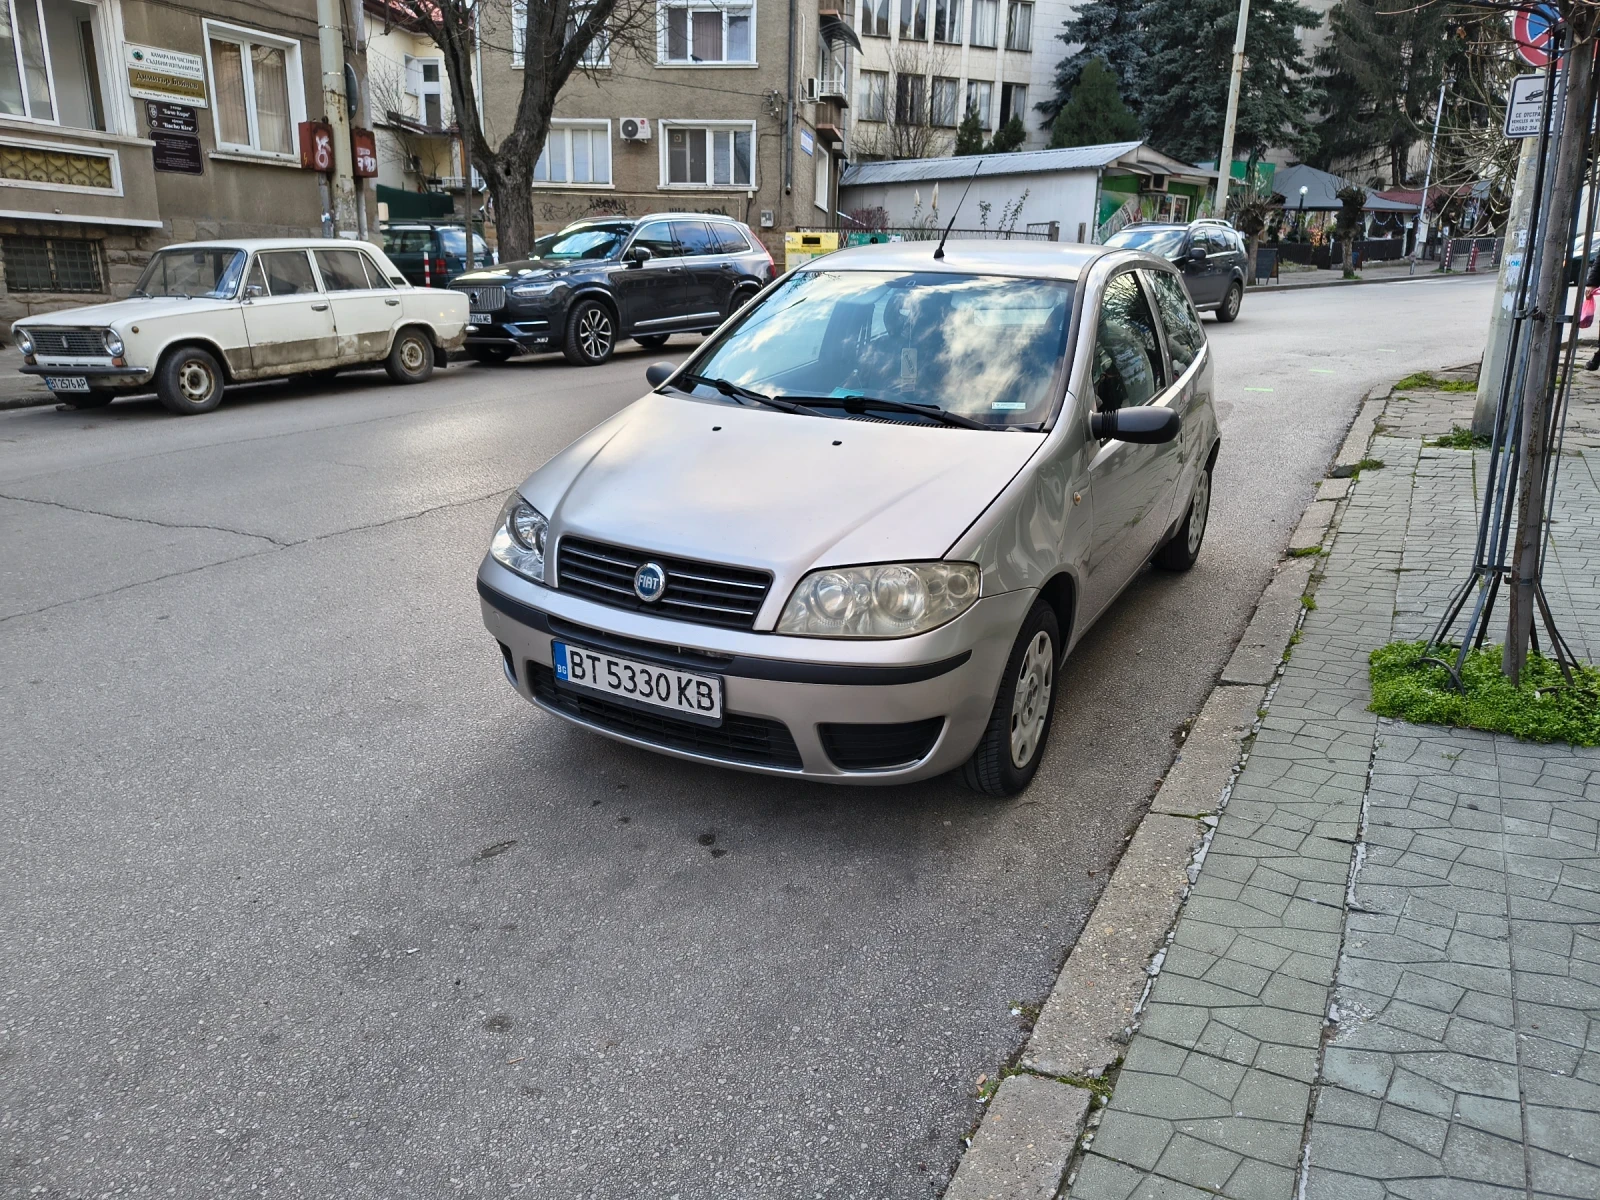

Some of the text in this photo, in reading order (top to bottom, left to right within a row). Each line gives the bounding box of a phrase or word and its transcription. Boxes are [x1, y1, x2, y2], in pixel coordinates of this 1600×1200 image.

[145, 58, 168, 68] СЪДЕБНИ
[168, 62, 201, 73] ИЗПЪЛНИТЕЛИ
[151, 51, 169, 60] КАМАРА
[177, 56, 199, 66] ЧАСТНИТЕ
[136, 72, 172, 87] Димитър
[638, 574, 659, 589] FIAT
[557, 664, 567, 675] BG
[570, 650, 715, 712] BT 5330 KB
